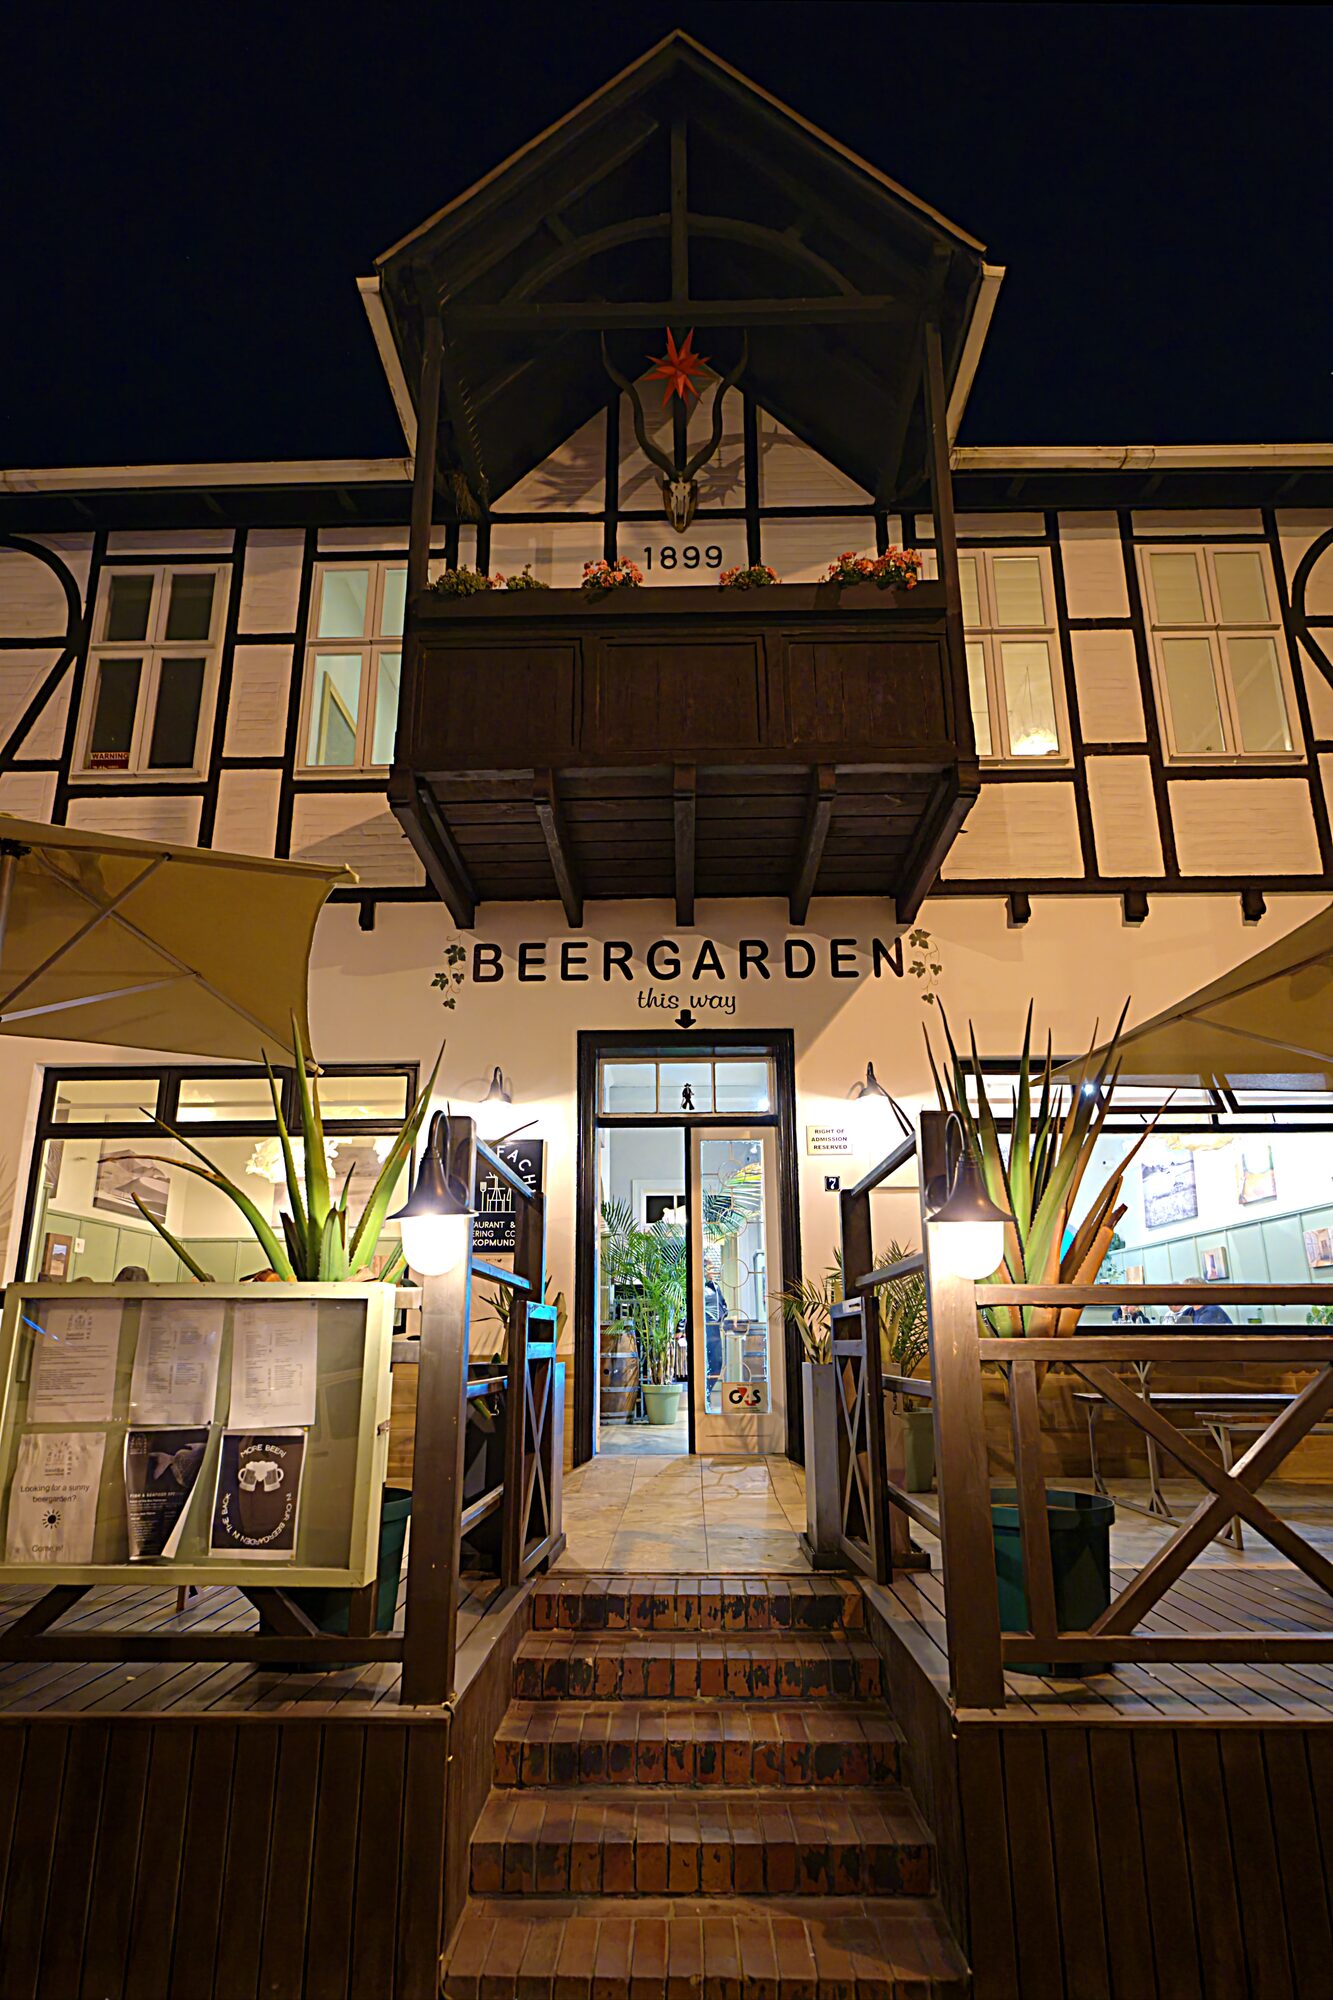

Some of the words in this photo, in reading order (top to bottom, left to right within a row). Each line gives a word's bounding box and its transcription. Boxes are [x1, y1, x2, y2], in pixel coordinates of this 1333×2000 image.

[643, 545, 723, 570] 1899
[472, 937, 904, 983] BEERGARDEN
[638, 987, 680, 1009] this
[690, 994, 736, 1015] way
[496, 1145, 537, 1192] FACH
[828, 1178, 836, 1189] 7
[473, 1221, 506, 1229] AURANT
[509, 1221, 516, 1229] &
[504, 1230, 516, 1238] CC
[472, 1238, 516, 1247] KOPMUND
[728, 1386, 762, 1407] G4S
[240, 1444, 263, 1458] MORE
[20, 1485, 50, 1493] Looking
[33, 1495, 77, 1504] beergarden?
